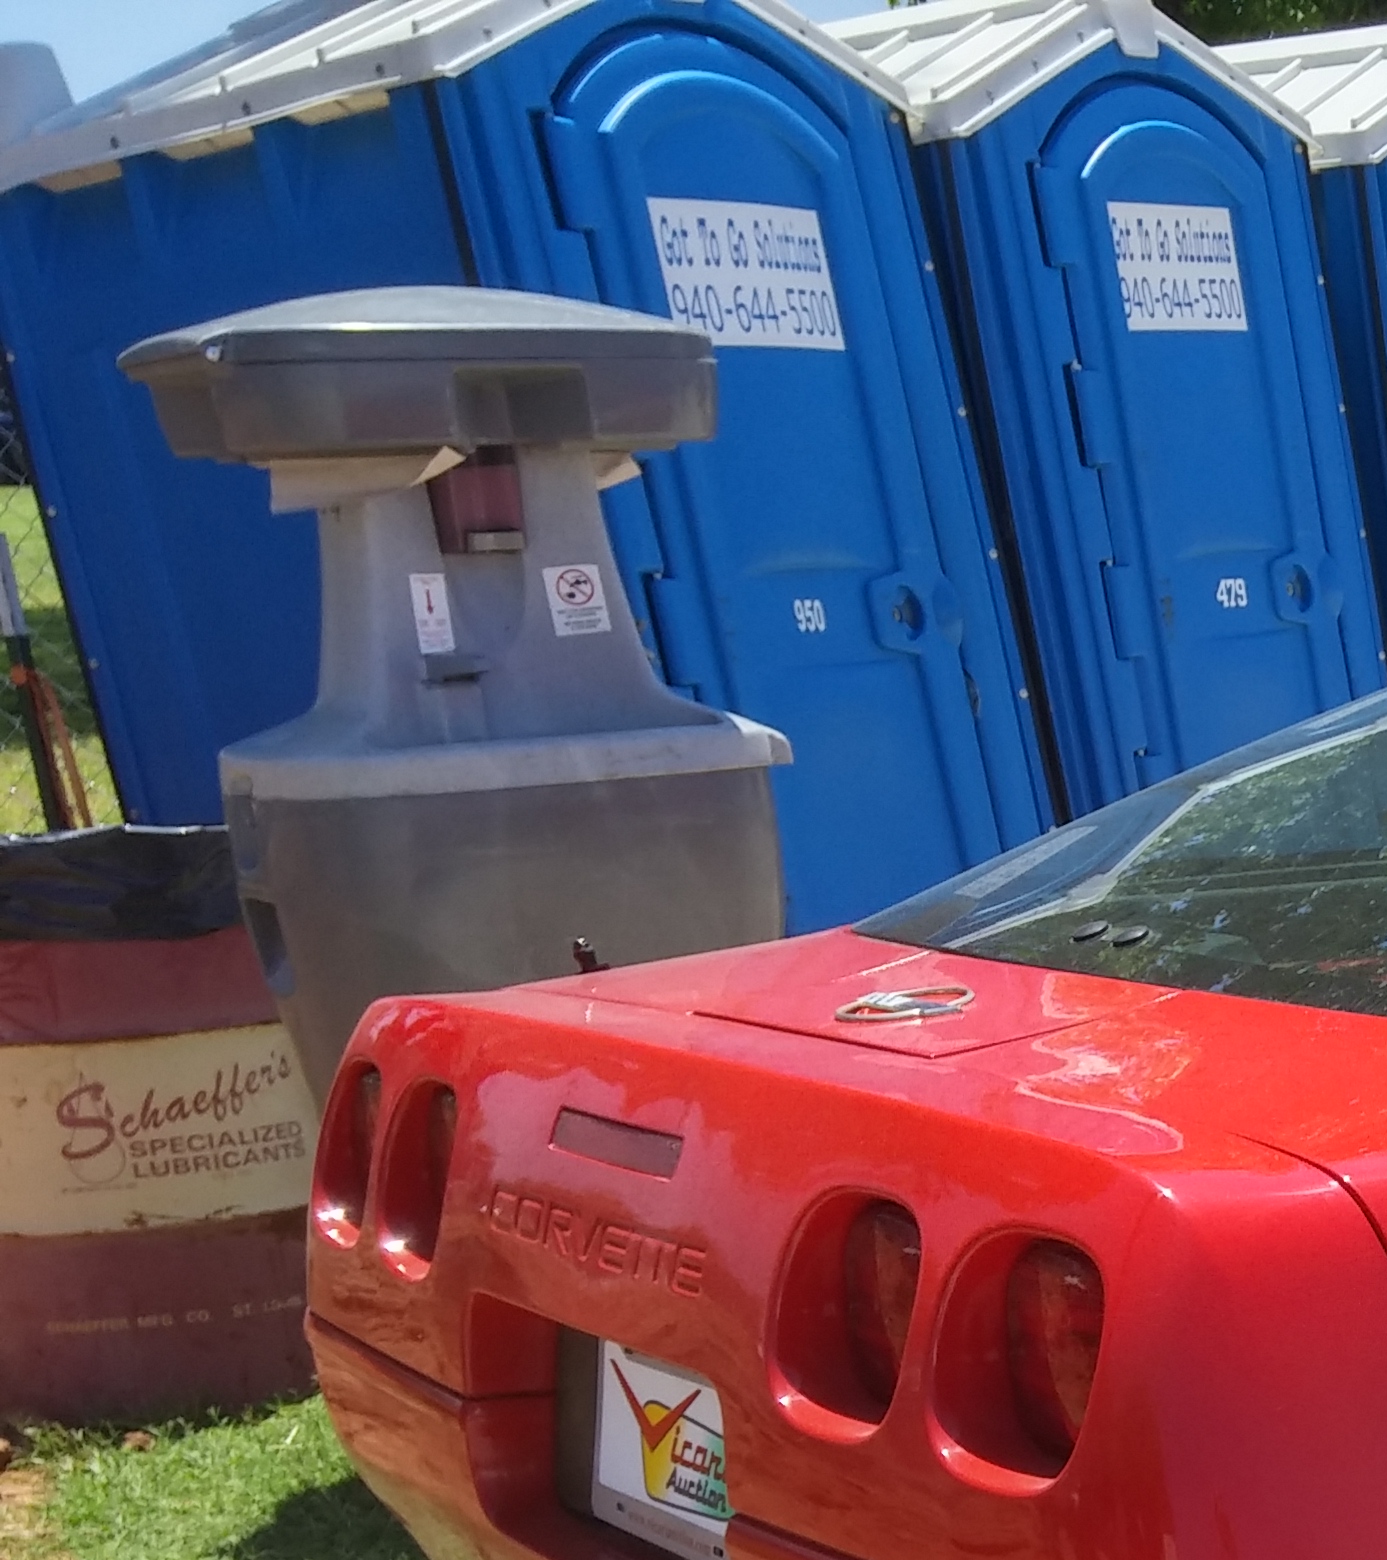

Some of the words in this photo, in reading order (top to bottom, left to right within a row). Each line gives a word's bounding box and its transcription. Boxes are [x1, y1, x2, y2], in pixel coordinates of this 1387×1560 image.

[660, 214, 693, 267] Got
[696, 217, 721, 268] To
[726, 218, 749, 268] Go
[753, 218, 822, 273] Solutions
[1111, 216, 1134, 262] Got
[1137, 218, 1152, 262] To
[1155, 218, 1170, 262] Go
[1174, 217, 1232, 264] Solutions
[672, 283, 836, 336] 940-644-5500
[1120, 276, 1242, 319] 940-644-5500
[794, 599, 826, 632] 950
[1216, 578, 1248, 608] 479
[56, 1050, 292, 1161] Schaeffer's
[129, 1121, 302, 1158] SPECIALIZED
[132, 1141, 307, 1179] LUBRICANTS
[490, 1184, 707, 1298] CORVETTE
